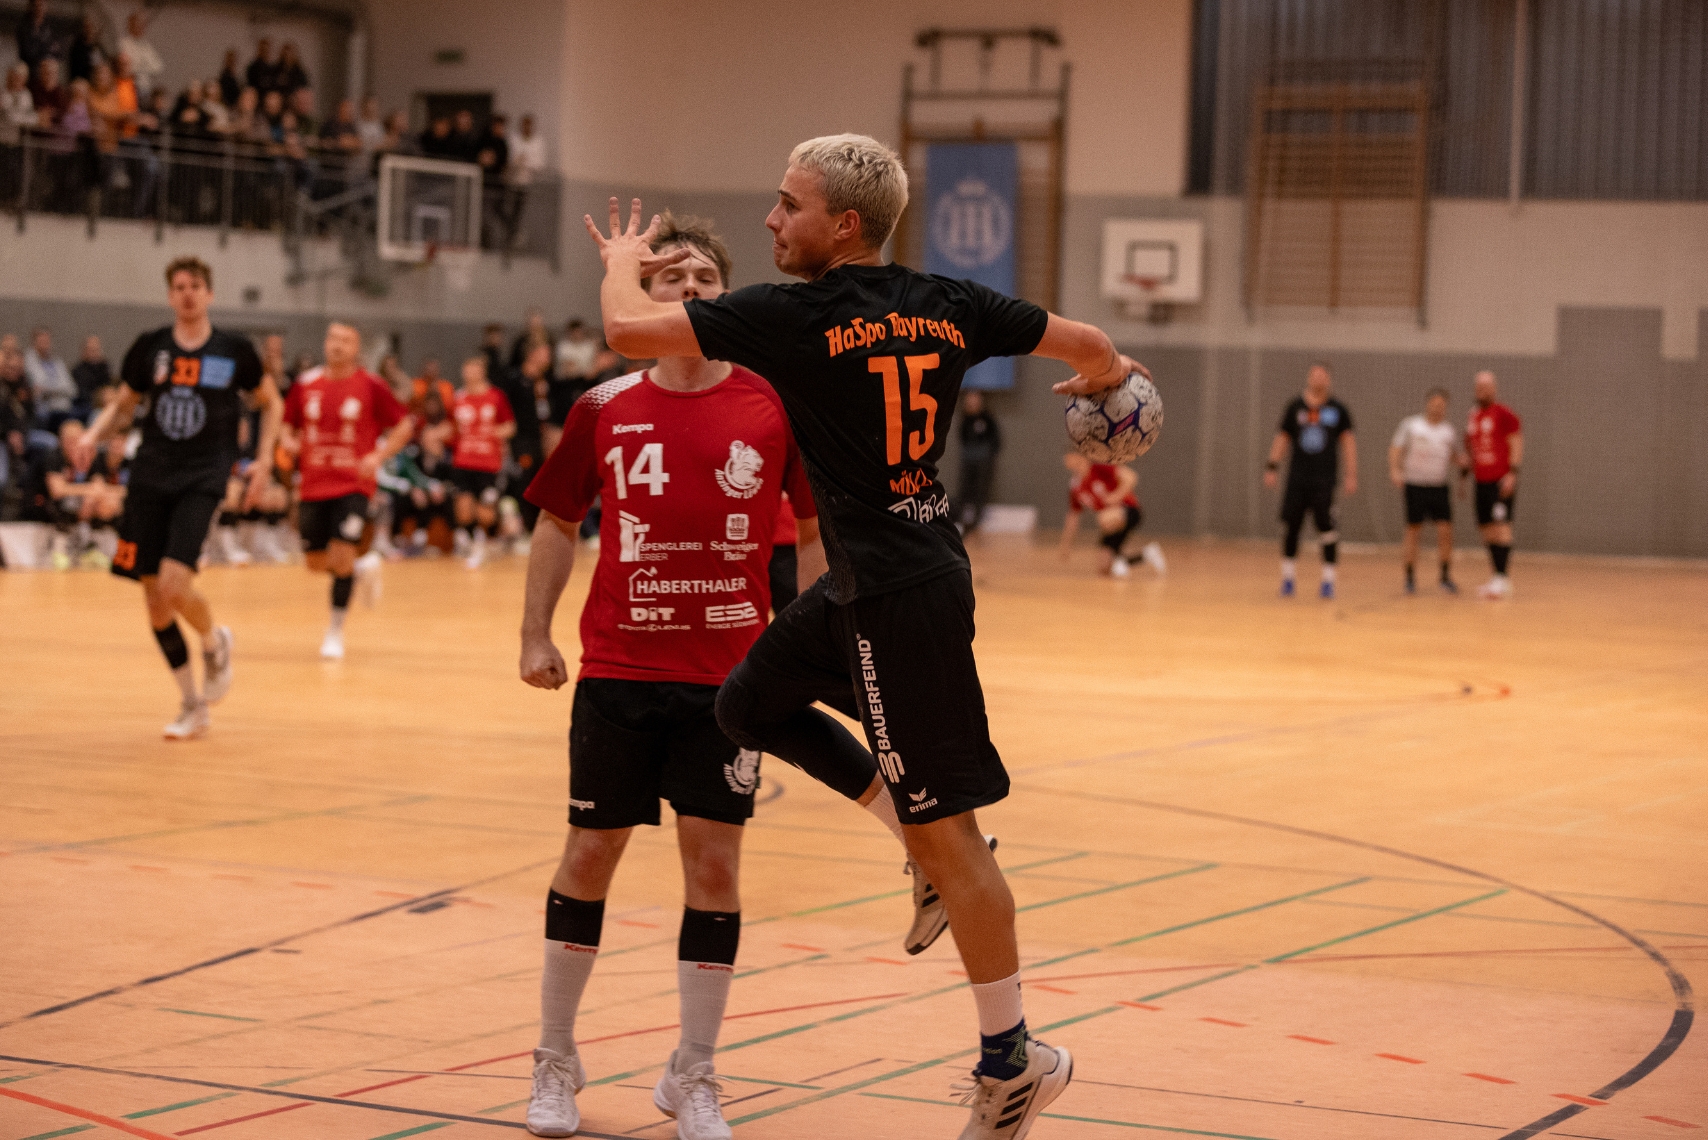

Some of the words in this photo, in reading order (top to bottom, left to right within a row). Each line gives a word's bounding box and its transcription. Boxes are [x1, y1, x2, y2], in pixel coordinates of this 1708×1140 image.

[824, 317, 886, 358] HaSpo
[867, 352, 940, 466] 15
[612, 423, 654, 435] Kempa
[604, 443, 671, 500] 14
[639, 542, 703, 551] SPENGLEREI
[636, 577, 747, 594] HABERTHALER
[858, 639, 892, 751] BAUERFEIND
[909, 797, 938, 813] erima
